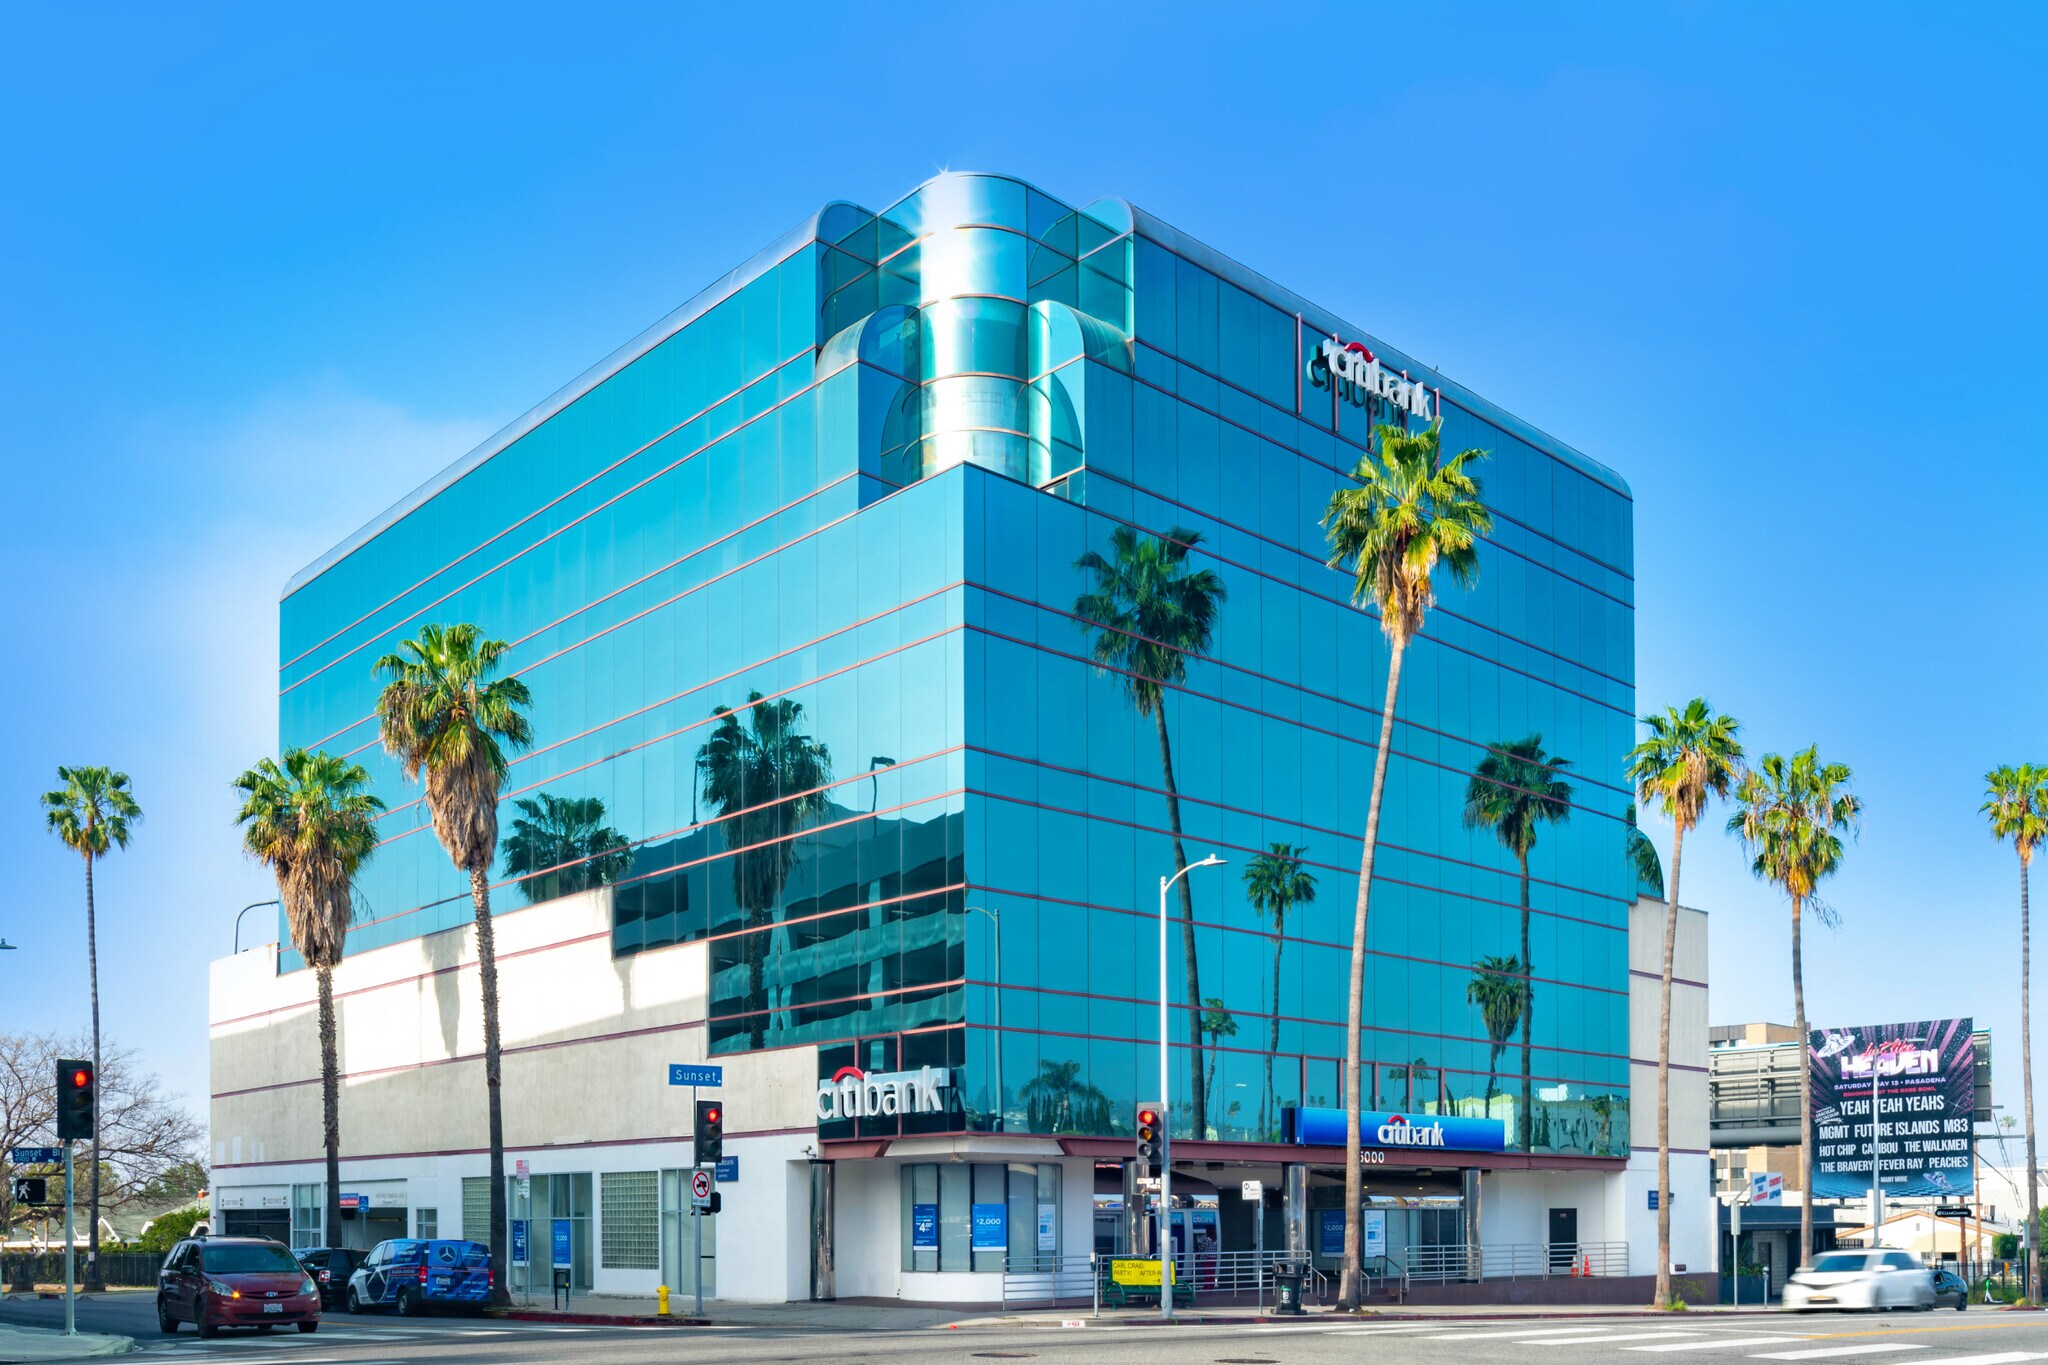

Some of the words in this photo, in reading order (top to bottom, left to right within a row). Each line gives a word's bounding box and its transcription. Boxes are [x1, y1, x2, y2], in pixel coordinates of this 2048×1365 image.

[1328, 345, 1432, 422] citibank
[1840, 1049, 1939, 1080] HEAVEN
[675, 1069, 717, 1082] Sunset
[1834, 1082, 1872, 1090] SATURDAY
[1905, 1077, 1946, 1085] PASADENA
[816, 1065, 943, 1120] citibank
[1840, 1100, 1870, 1116] YEAH
[1907, 1095, 1945, 1112] YEAHS
[1377, 1118, 1445, 1147] citibank
[1819, 1125, 1850, 1140] MGMT
[1895, 1120, 1940, 1136] ISLANDS
[1944, 1118, 1968, 1133] M83
[14, 1148, 42, 1157] Sunset
[1819, 1144, 1836, 1157] HOT
[1837, 1144, 1857, 1156] CHIP
[1861, 1142, 1899, 1155] CAIBOU
[1904, 1141, 1921, 1153] THE
[1922, 1139, 1968, 1152] WALKMEN
[1820, 1161, 1836, 1173] THE
[1837, 1160, 1874, 1172] BRAVERY
[1879, 1159, 1905, 1170] FEVER
[1906, 1158, 1924, 1169] RAY
[1928, 1156, 1969, 1169] PEACHES
[1894, 1175, 1908, 1183] MORE
